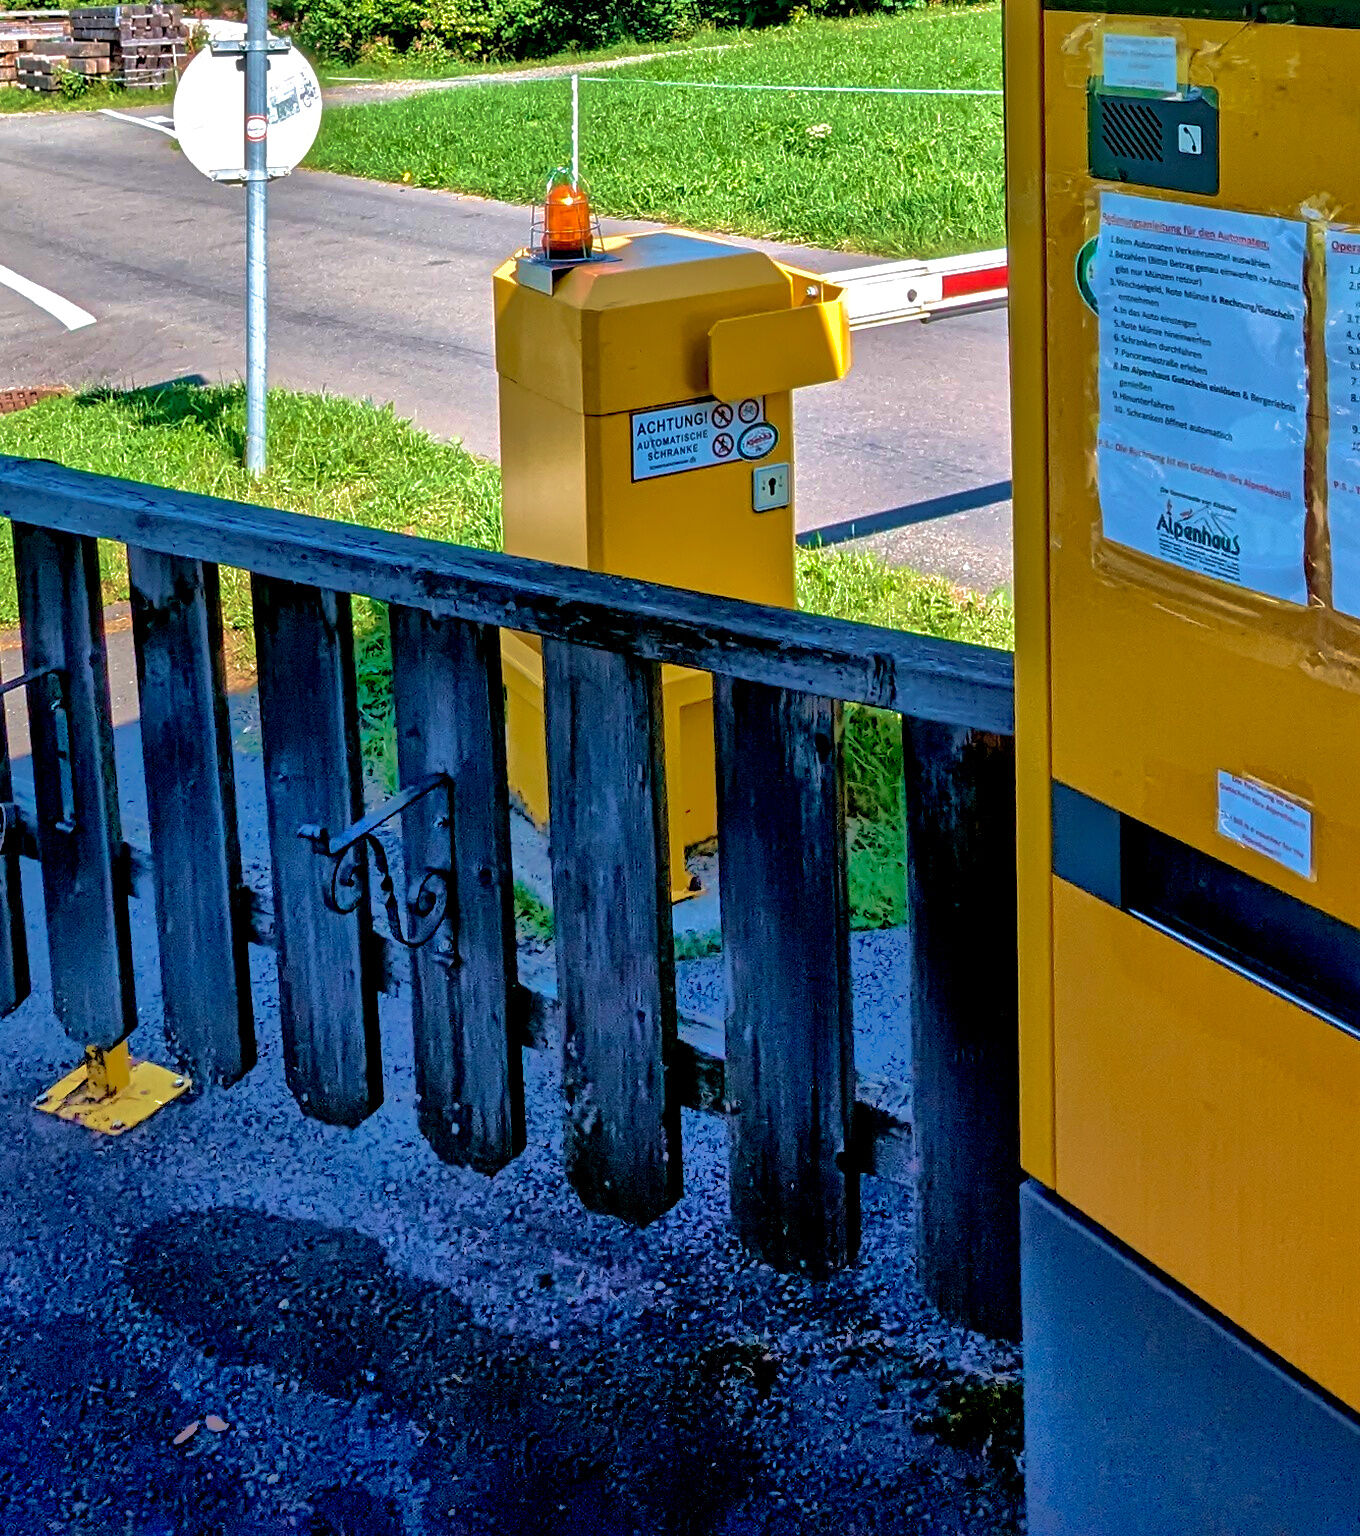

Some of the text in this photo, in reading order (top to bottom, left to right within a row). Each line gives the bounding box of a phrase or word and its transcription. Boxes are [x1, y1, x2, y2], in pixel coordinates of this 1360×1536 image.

[637, 411, 708, 437] ACHTUNG!
[637, 430, 709, 452] AUTOMATISCHE
[648, 443, 698, 462] SCHRANKE
